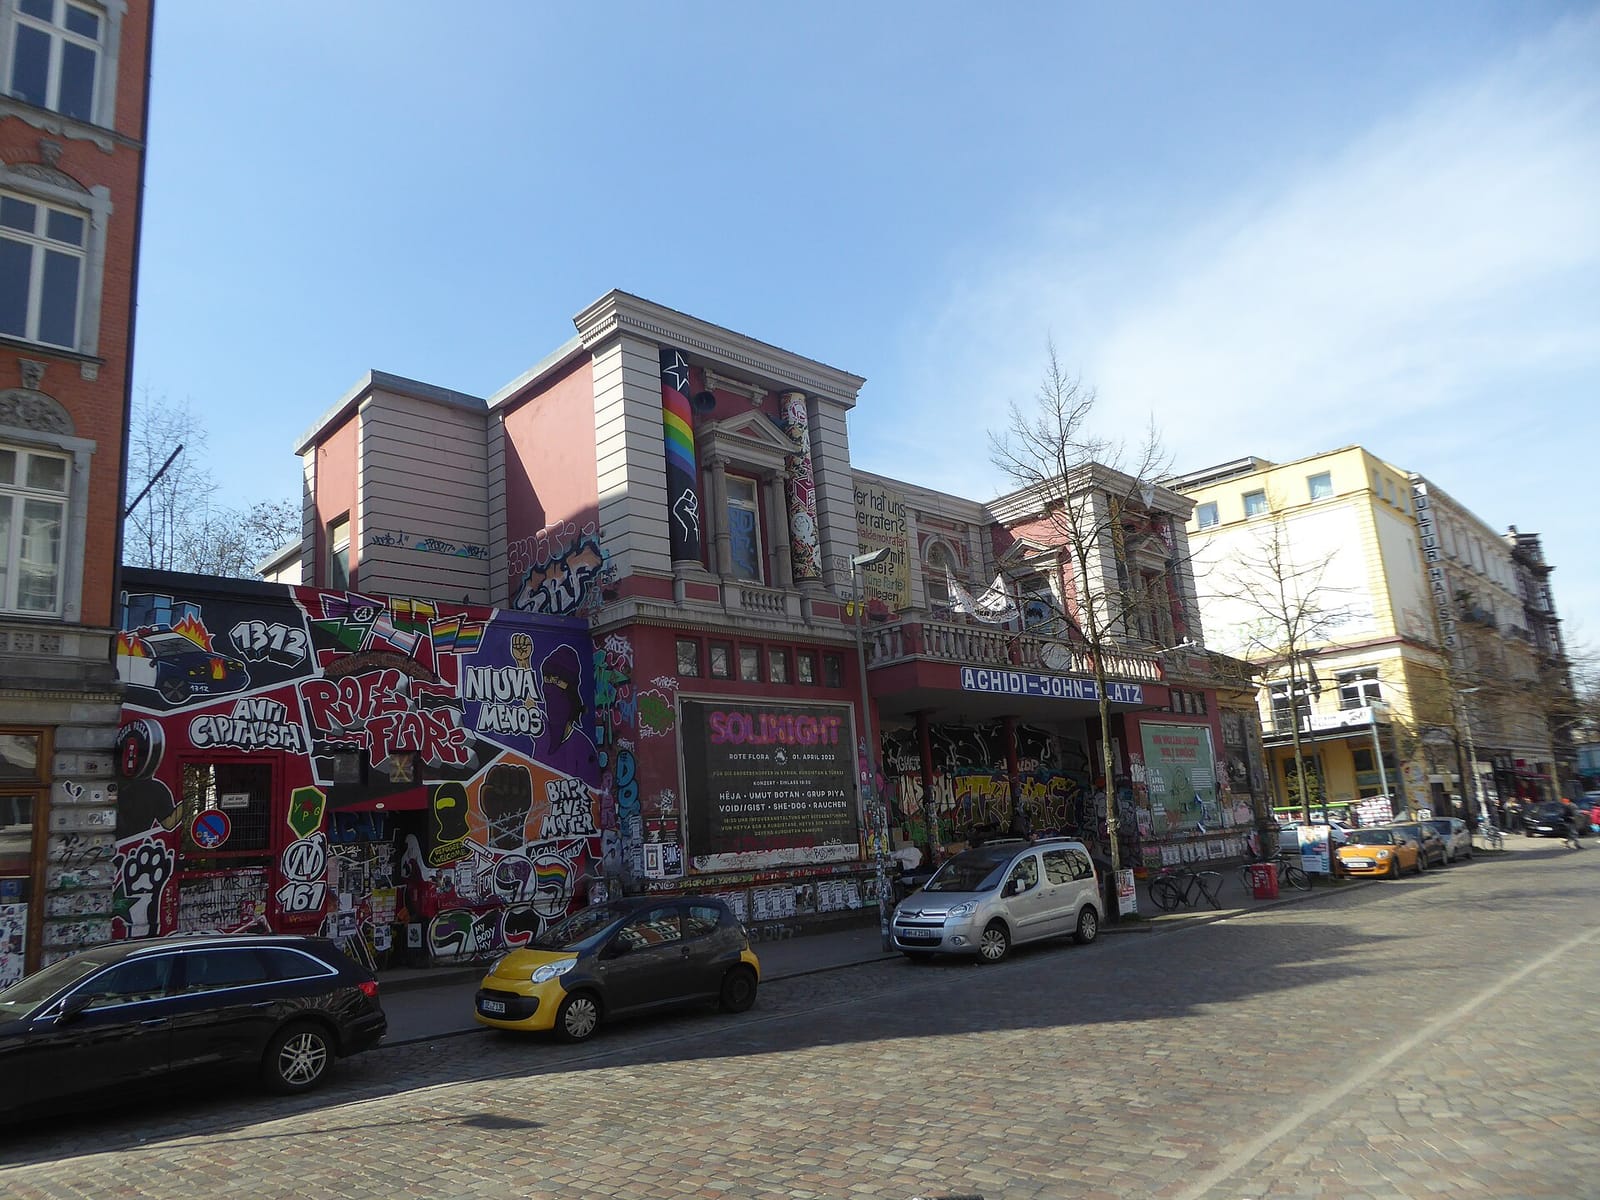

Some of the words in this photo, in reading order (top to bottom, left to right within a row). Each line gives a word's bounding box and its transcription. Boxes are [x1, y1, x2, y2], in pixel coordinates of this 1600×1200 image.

[870, 489, 886, 511] hat
[888, 500, 906, 518] uns
[231, 621, 306, 664] 1312
[233, 699, 287, 722] ANTI
[300, 668, 408, 731] ROTE
[478, 704, 544, 735] MENOS
[191, 716, 303, 750] CAPITALISTA
[546, 779, 592, 802] BLACK
[749, 791, 772, 799] UMUT
[774, 791, 800, 799] BOTAN
[806, 790, 825, 798] GRUP
[551, 799, 591, 817] LIVES
[813, 801, 847, 809] RAUCHEN
[541, 813, 597, 838] MATTER
[276, 881, 326, 912] 161
[475, 922, 485, 935] MY
[476, 926, 496, 944] BODY
[479, 939, 491, 950] MY
